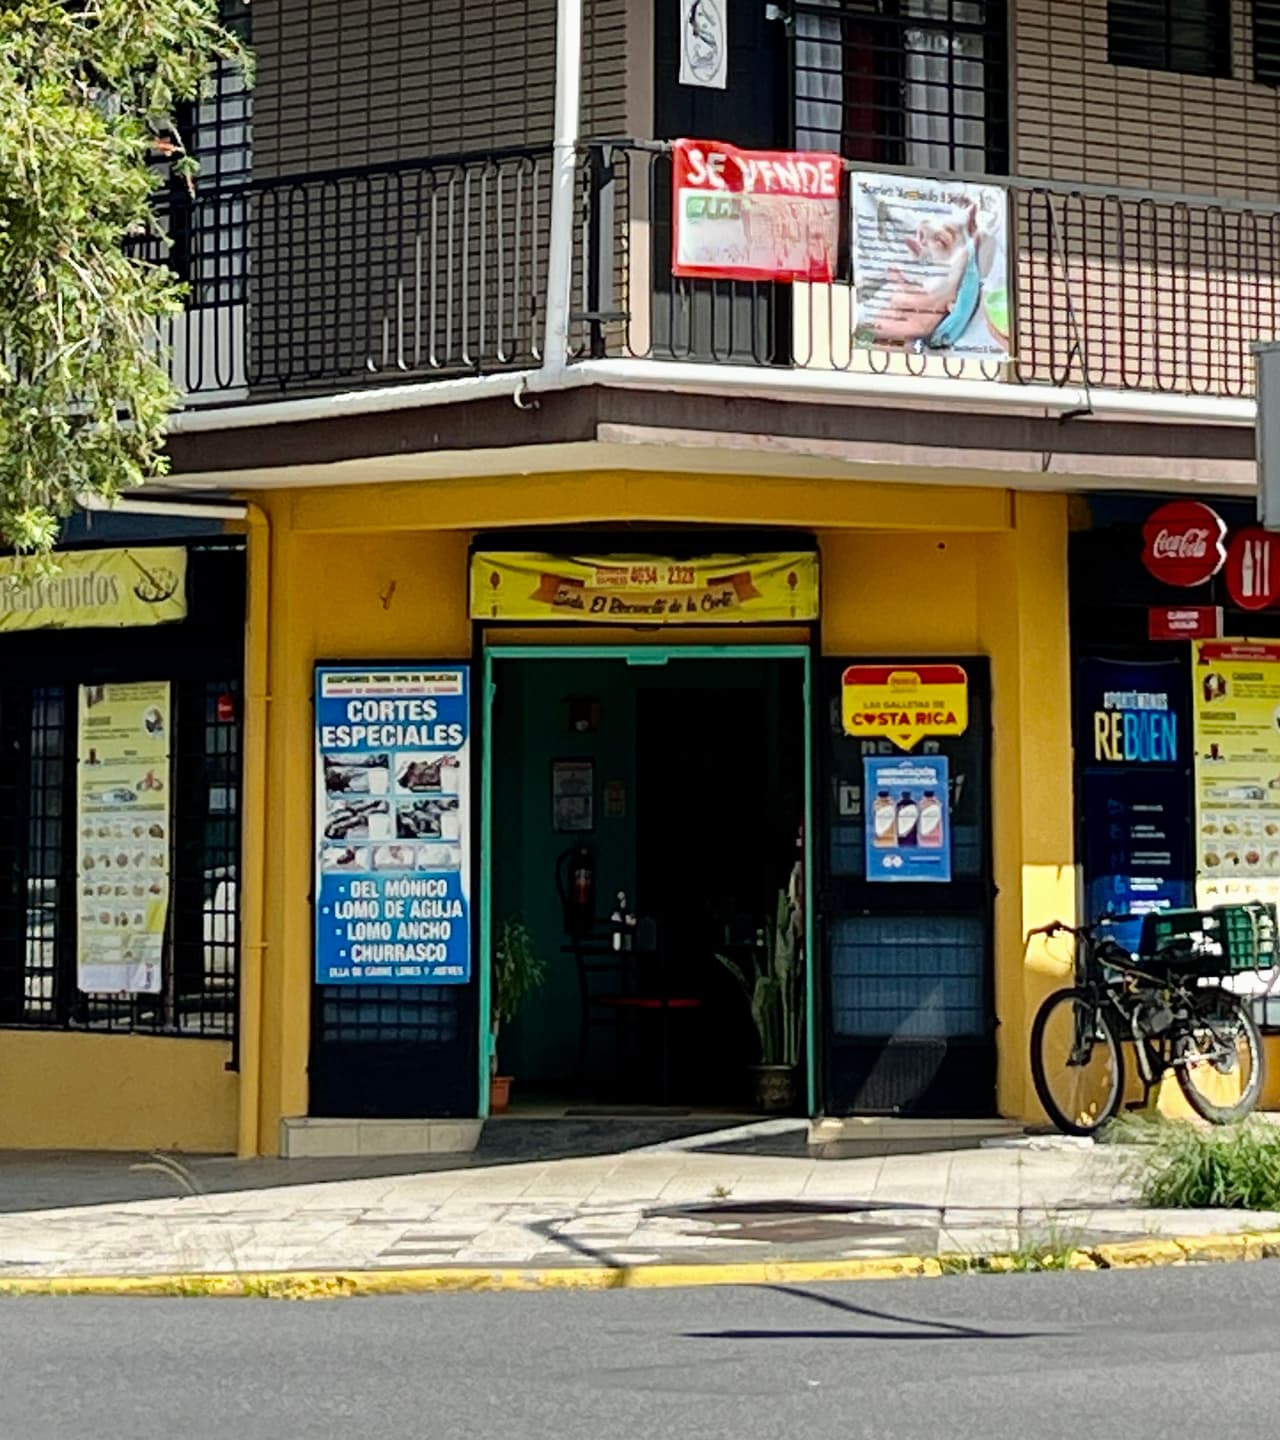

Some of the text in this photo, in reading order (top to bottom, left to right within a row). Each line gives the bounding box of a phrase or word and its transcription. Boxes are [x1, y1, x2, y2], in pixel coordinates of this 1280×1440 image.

[687, 149, 836, 194] SE VENDE
[347, 699, 437, 722] CORTES
[915, 712, 958, 725] RICA
[322, 724, 463, 747] ESPECIALES
[351, 880, 379, 898] DEL
[335, 899, 463, 919] LOMO DE AGUJA
[347, 921, 451, 941] LOMO ANCHO
[351, 944, 447, 963] CHURRASCO
